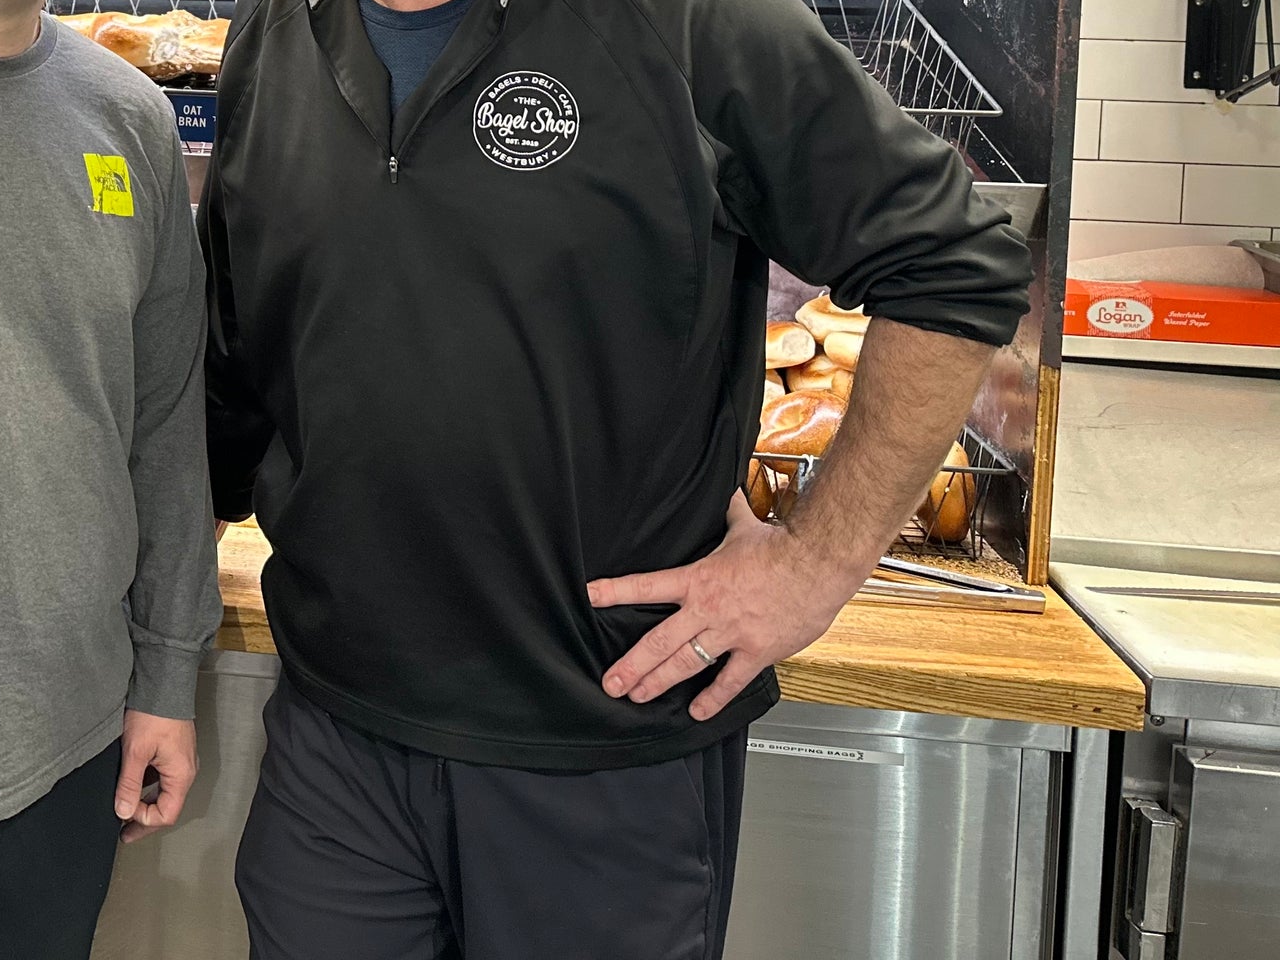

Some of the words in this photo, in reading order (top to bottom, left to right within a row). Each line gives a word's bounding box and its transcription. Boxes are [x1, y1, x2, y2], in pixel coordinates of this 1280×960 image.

[488, 76, 521, 99] BAGELS
[531, 77, 554, 89] DELI
[558, 94, 573, 116] CAFE
[517, 96, 537, 105] THE
[183, 105, 202, 115] OAT
[178, 116, 206, 128] BRAN
[477, 102, 528, 136] Bagel
[530, 107, 575, 139] Shop
[491, 147, 549, 166] WESTBURY
[1096, 306, 1145, 324] Logan
[769, 745, 823, 754] SHOPPING
[827, 750, 856, 758] BAGS
